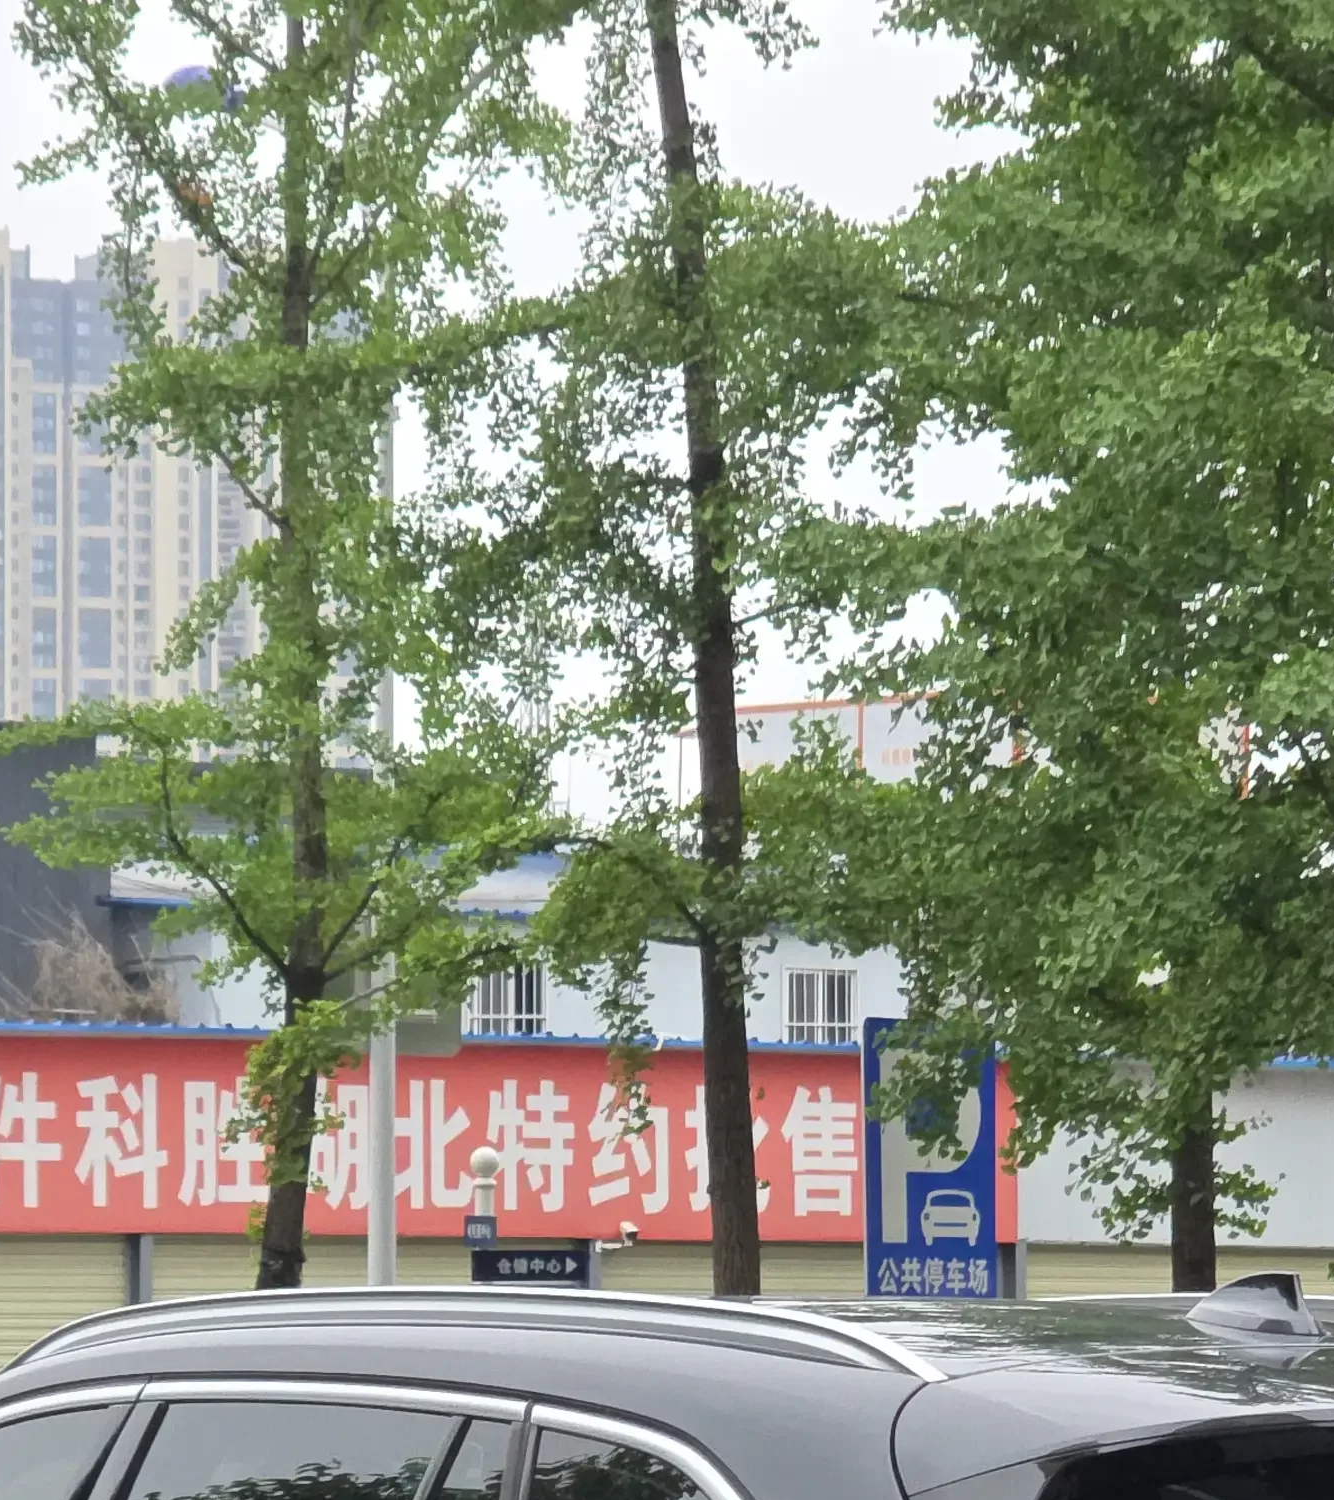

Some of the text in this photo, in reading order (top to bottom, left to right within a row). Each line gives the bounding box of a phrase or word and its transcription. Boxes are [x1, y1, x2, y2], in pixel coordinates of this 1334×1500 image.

[878, 1257, 988, 1295] 公共停车场
